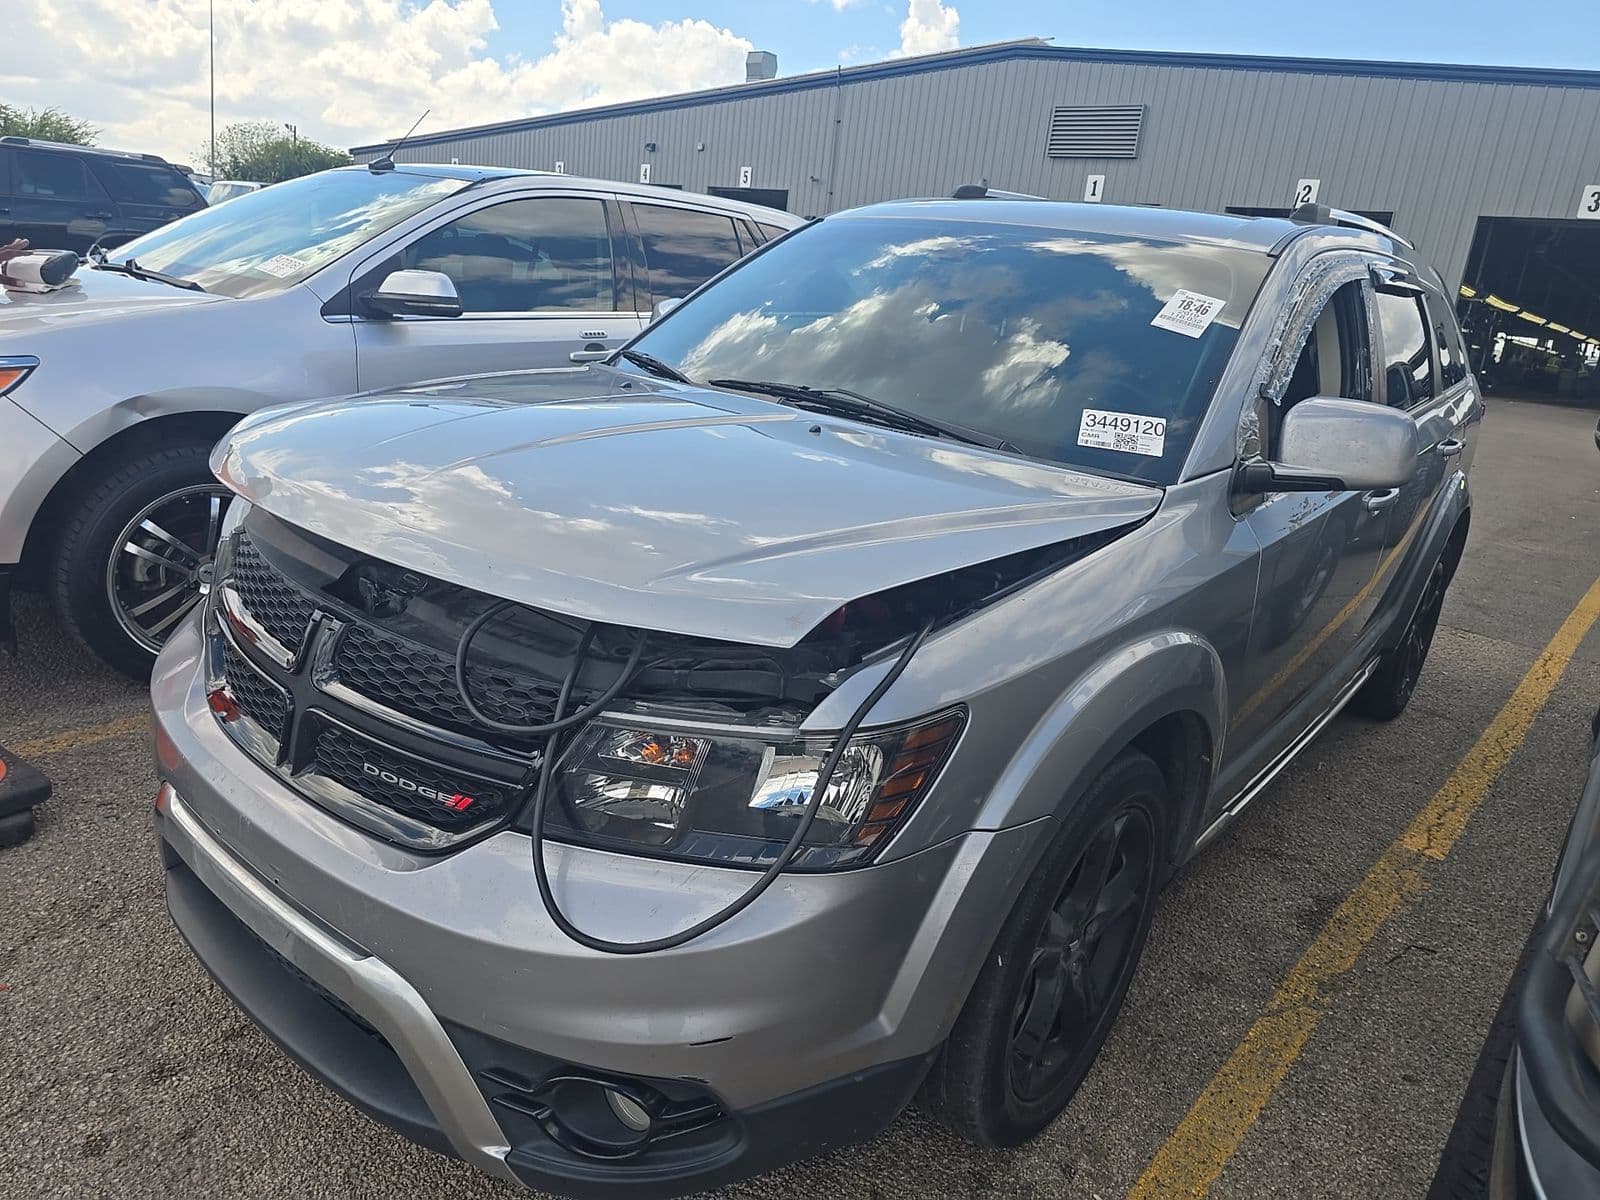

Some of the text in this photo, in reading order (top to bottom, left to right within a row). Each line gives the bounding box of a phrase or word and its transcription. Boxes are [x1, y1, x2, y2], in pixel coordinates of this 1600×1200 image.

[642, 167, 648, 180] 4
[743, 170, 749, 184] 5
[1090, 180, 1098, 196] 1
[1300, 185, 1312, 203] 2
[1587, 191, 1600, 213] 3
[1177, 299, 1212, 316] 18:46
[1085, 413, 1165, 437] 3449120
[363, 762, 456, 806] DODGE
